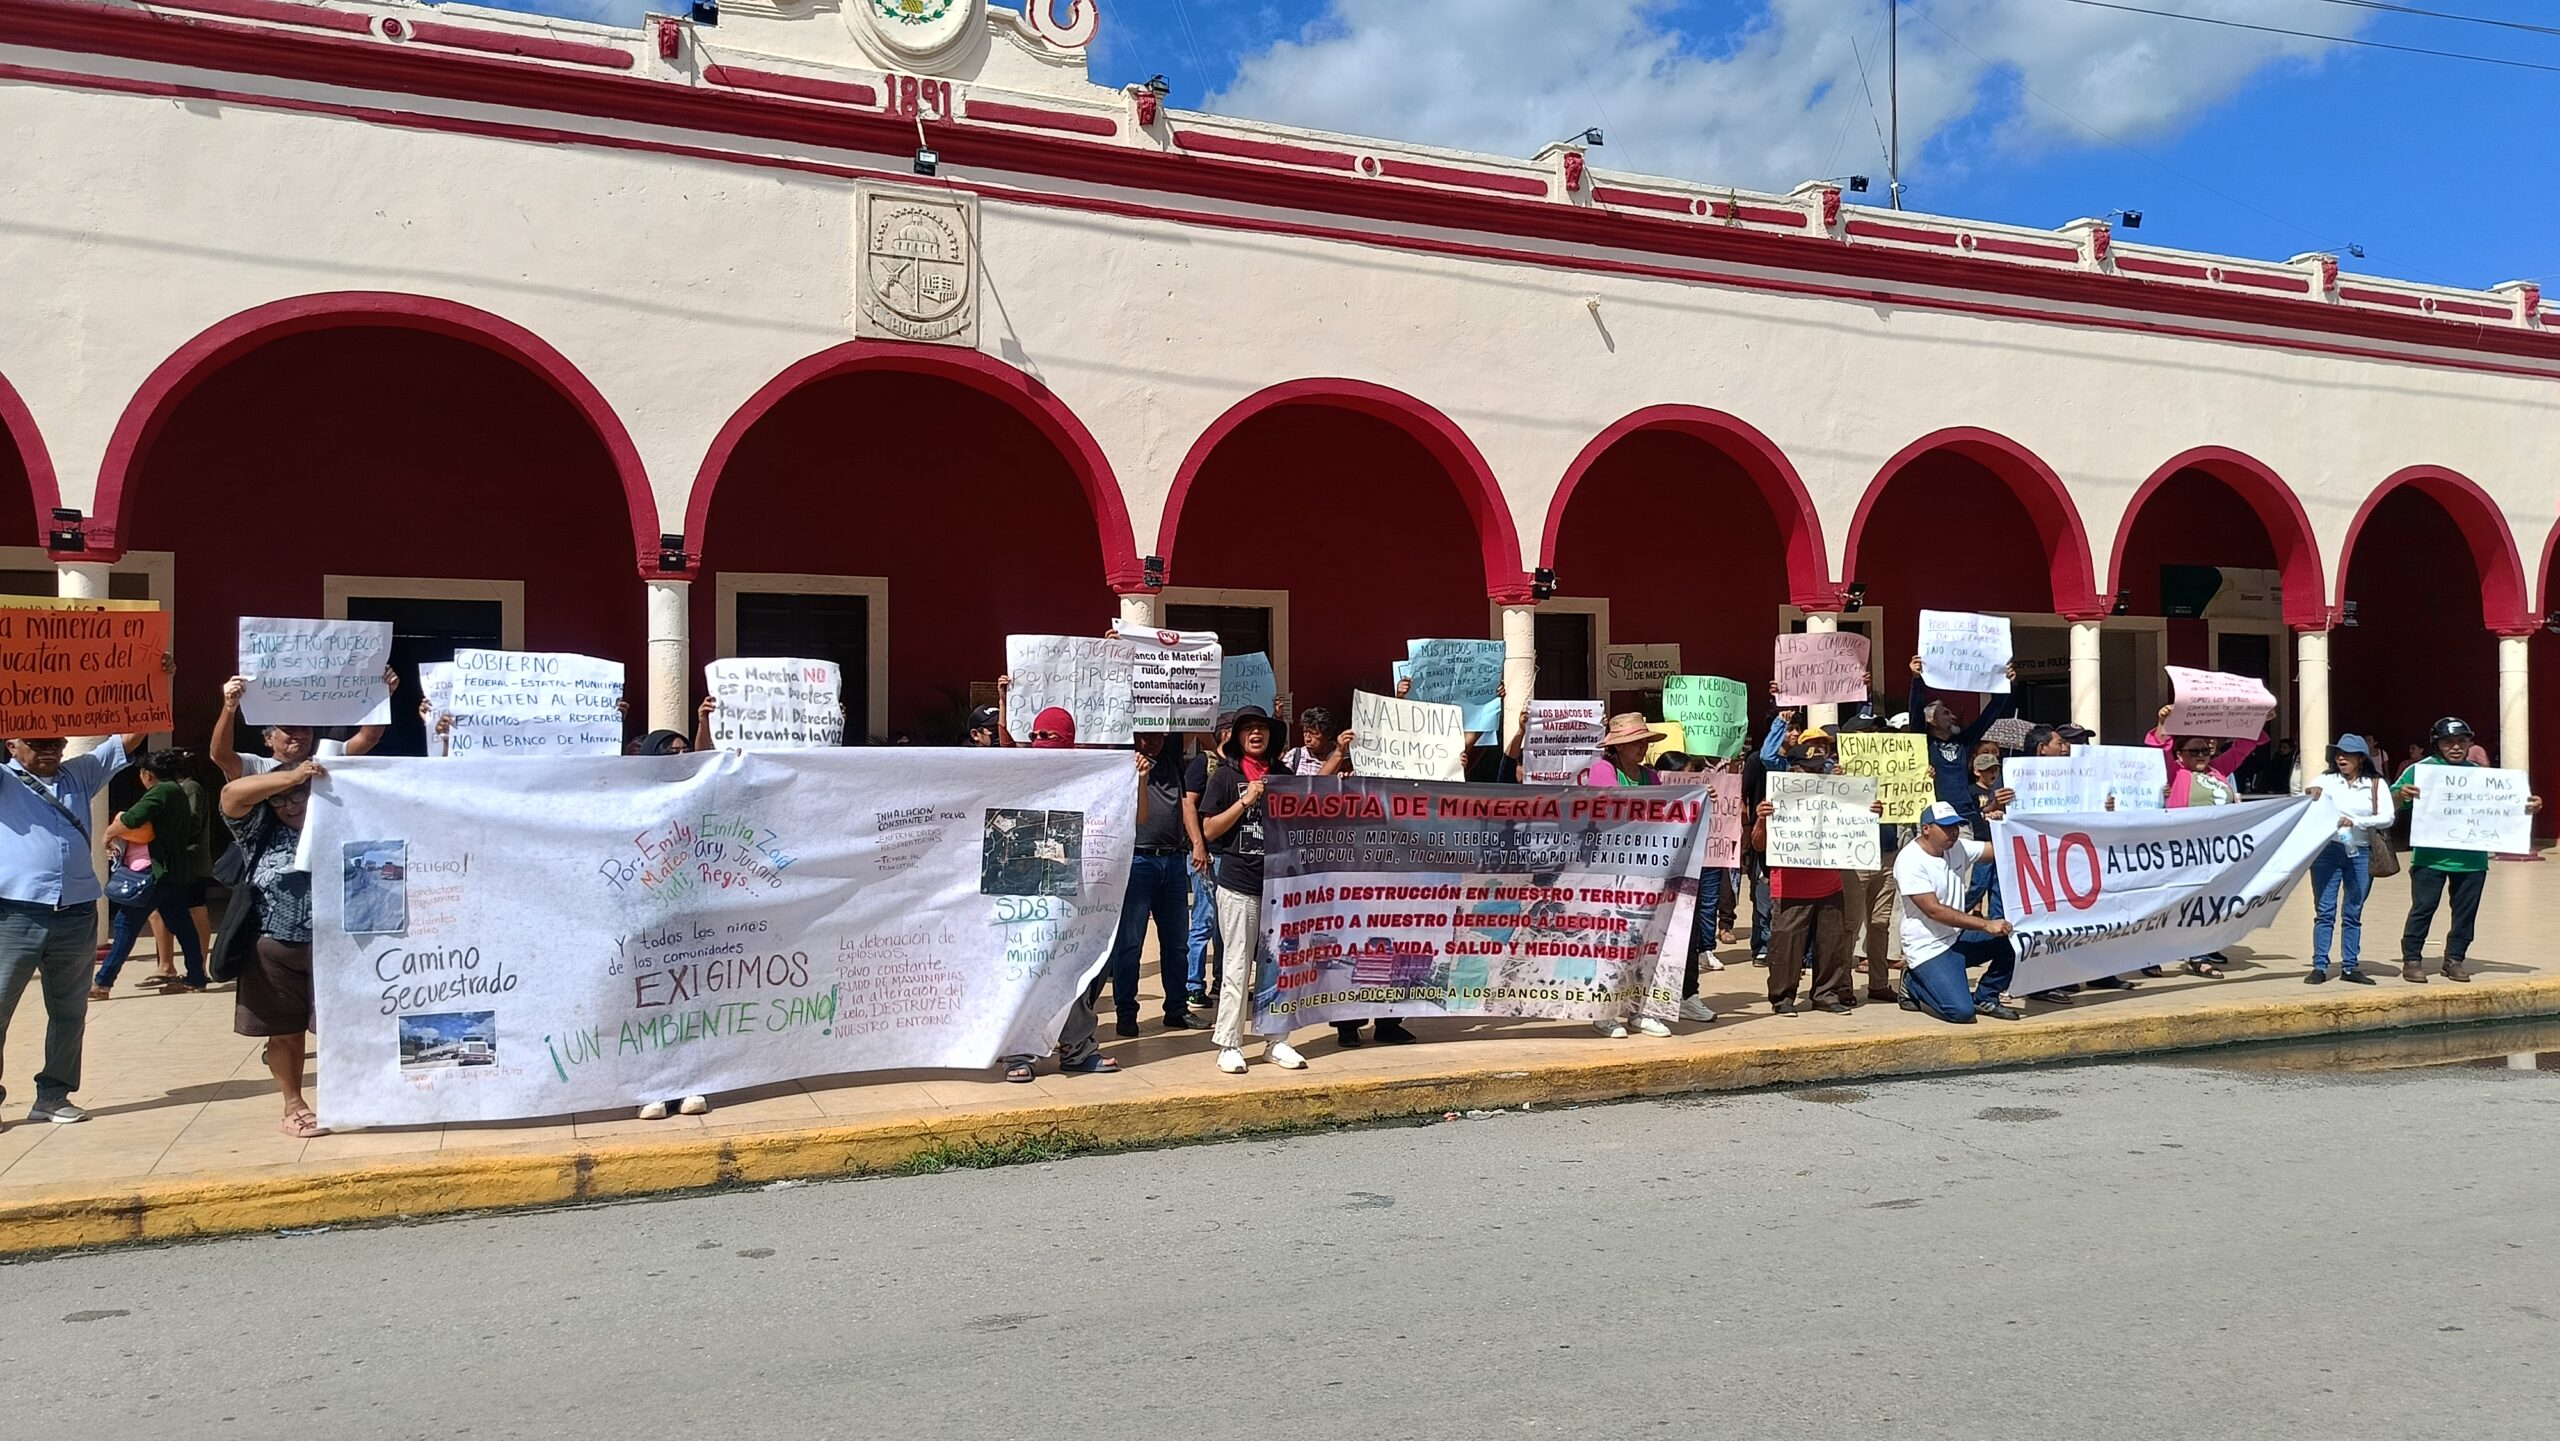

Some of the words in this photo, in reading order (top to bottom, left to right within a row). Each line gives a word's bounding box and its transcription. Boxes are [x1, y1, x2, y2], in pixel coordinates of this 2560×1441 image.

[885, 73, 951, 118] 1891
[26, 612, 111, 639] minería
[124, 618, 144, 638] en
[1421, 643, 1439, 657] MIS
[1777, 637, 1808, 654] LAS
[1952, 647, 1967, 656] CON
[80, 651, 100, 672] es
[105, 643, 132, 668] del
[261, 657, 276, 669] NO
[283, 657, 300, 668] SE
[308, 655, 357, 669] VENDE
[456, 653, 559, 674] GOBIERNO
[1159, 651, 1169, 660] de
[1172, 651, 1214, 661] Material:
[1633, 660, 1669, 669] CORREOS
[716, 665, 739, 680] La
[803, 667, 826, 683] NO
[1141, 665, 1168, 676] ruido,
[1171, 667, 1198, 677] polvo,
[1634, 672, 1645, 680] DE
[86, 673, 153, 706] criminal
[261, 676, 326, 690] NUESTRO
[1133, 679, 1198, 691] contaminación
[267, 691, 292, 701] SE
[454, 693, 538, 706] MIENTEN
[551, 694, 567, 706] AL
[718, 683, 738, 695] es
[744, 684, 785, 702] para
[788, 685, 834, 705] moles
[1177, 696, 1187, 705] de
[85, 710, 120, 728] explotes
[456, 714, 520, 727] EXIGIMOS
[533, 715, 561, 723] SER
[1133, 717, 1162, 726] PUEBLO
[1188, 717, 1210, 726] UNIDO
[1539, 709, 1553, 718] LOS
[1555, 709, 1582, 718] BANCOS
[1584, 709, 1593, 718] DE
[1680, 711, 1719, 722] BANCOS
[1723, 712, 1735, 724] DE
[504, 735, 546, 745] BANCO
[557, 735, 574, 745] DE
[714, 722, 733, 740] de
[739, 724, 806, 742] levantar
[1530, 736, 1543, 744] son
[1544, 734, 1569, 744] heridas
[1570, 734, 1598, 743] abiertas
[1362, 731, 1448, 759] EXIGIMOS
[1533, 749, 1546, 758] que
[1354, 751, 1405, 771] CUMPLAS
[1414, 762, 1435, 776] TU
[1887, 755, 1916, 773] QUÉ
[1531, 772, 1541, 781] ME
[1544, 771, 1572, 781] DUELES
[2445, 775, 2467, 788] NO
[2485, 777, 2512, 790] MAS
[1772, 776, 1849, 795] RESPETO
[1863, 783, 1871, 793] A
[1269, 794, 1384, 818] ¡BASTA
[1391, 794, 1428, 819] DE
[1438, 794, 1560, 820] MINERÍA
[1571, 795, 1701, 823] PÉTREA!
[1797, 800, 1842, 812] FLORA,
[2443, 807, 2463, 816] QUE
[878, 816, 923, 831] CONSTANTE
[924, 813, 936, 822] DE
[2467, 818, 2480, 826] MI
[1288, 829, 1355, 846] PUEBLOS
[1364, 830, 1419, 846] MAYAS
[1427, 831, 1446, 846] DE
[2447, 828, 2500, 839] CASA
[1773, 841, 1800, 851] VIDA
[1808, 841, 1837, 850] SANA
[600, 857, 645, 891] Por:
[635, 820, 698, 861] Emily,
[1300, 849, 1354, 864] XCUCUL
[1409, 849, 1475, 864] TICIMUL
[1484, 851, 1493, 864] Y
[1500, 850, 1582, 865] YAXCOPOIL
[1773, 853, 1838, 866] TRANQUILA
[640, 850, 691, 891] Mateo,
[732, 845, 782, 889] Juanito
[2012, 832, 2103, 915] NO
[2107, 844, 2121, 874] A
[2126, 842, 2165, 872] LOS
[2171, 833, 2255, 868] BANCOS
[1282, 891, 1301, 908] NO
[1305, 886, 1335, 905] MÁS
[1339, 884, 1462, 901] DESTRUCCIÓN
[1465, 886, 1489, 900] EN
[1494, 886, 1574, 902] NUESTRO
[997, 897, 1049, 921] SDS
[1280, 914, 1344, 938] RESPETO
[1349, 914, 1362, 928] A
[1366, 913, 1448, 928] NUESTRO
[1452, 914, 1531, 928] DERECHO
[1537, 914, 1550, 928] A
[1555, 914, 1628, 932] DECIDIR
[615, 935, 626, 957] Y
[840, 936, 854, 950] La
[860, 925, 930, 949] detonación
[938, 925, 955, 944] de
[2017, 931, 2043, 962] DE
[376, 945, 479, 982] Camino
[608, 961, 625, 976] de
[634, 956, 652, 969] las
[663, 941, 744, 964] comunidades
[1278, 943, 1342, 968] RESPETO
[1347, 943, 1359, 957] A
[1363, 942, 1387, 957] LA
[1393, 941, 1440, 957] VIDA,
[1445, 941, 1503, 955] SALUD
[1507, 942, 1519, 955] Y
[381, 962, 517, 1015] Secuestrado
[634, 951, 808, 1009] EXIGIMOS
[1277, 968, 1318, 992] DIGNO
[945, 983, 963, 997] del
[869, 997, 960, 1018] DESTRUYEN
[1270, 1000, 1297, 1015] LOS
[1300, 989, 1356, 1010] PUEBLOS
[1360, 987, 1405, 1000] DICEN
[1410, 986, 1442, 999] ¡NO!
[1448, 987, 1457, 999] A
[1463, 986, 1492, 999] LOS
[1497, 987, 1559, 1001] BANCOS
[1565, 989, 1585, 1002] DE
[618, 1001, 759, 1056] AMBIENTE
[835, 1020, 889, 1039] NUESTRO
[896, 1015, 951, 1028] ENTORNO
